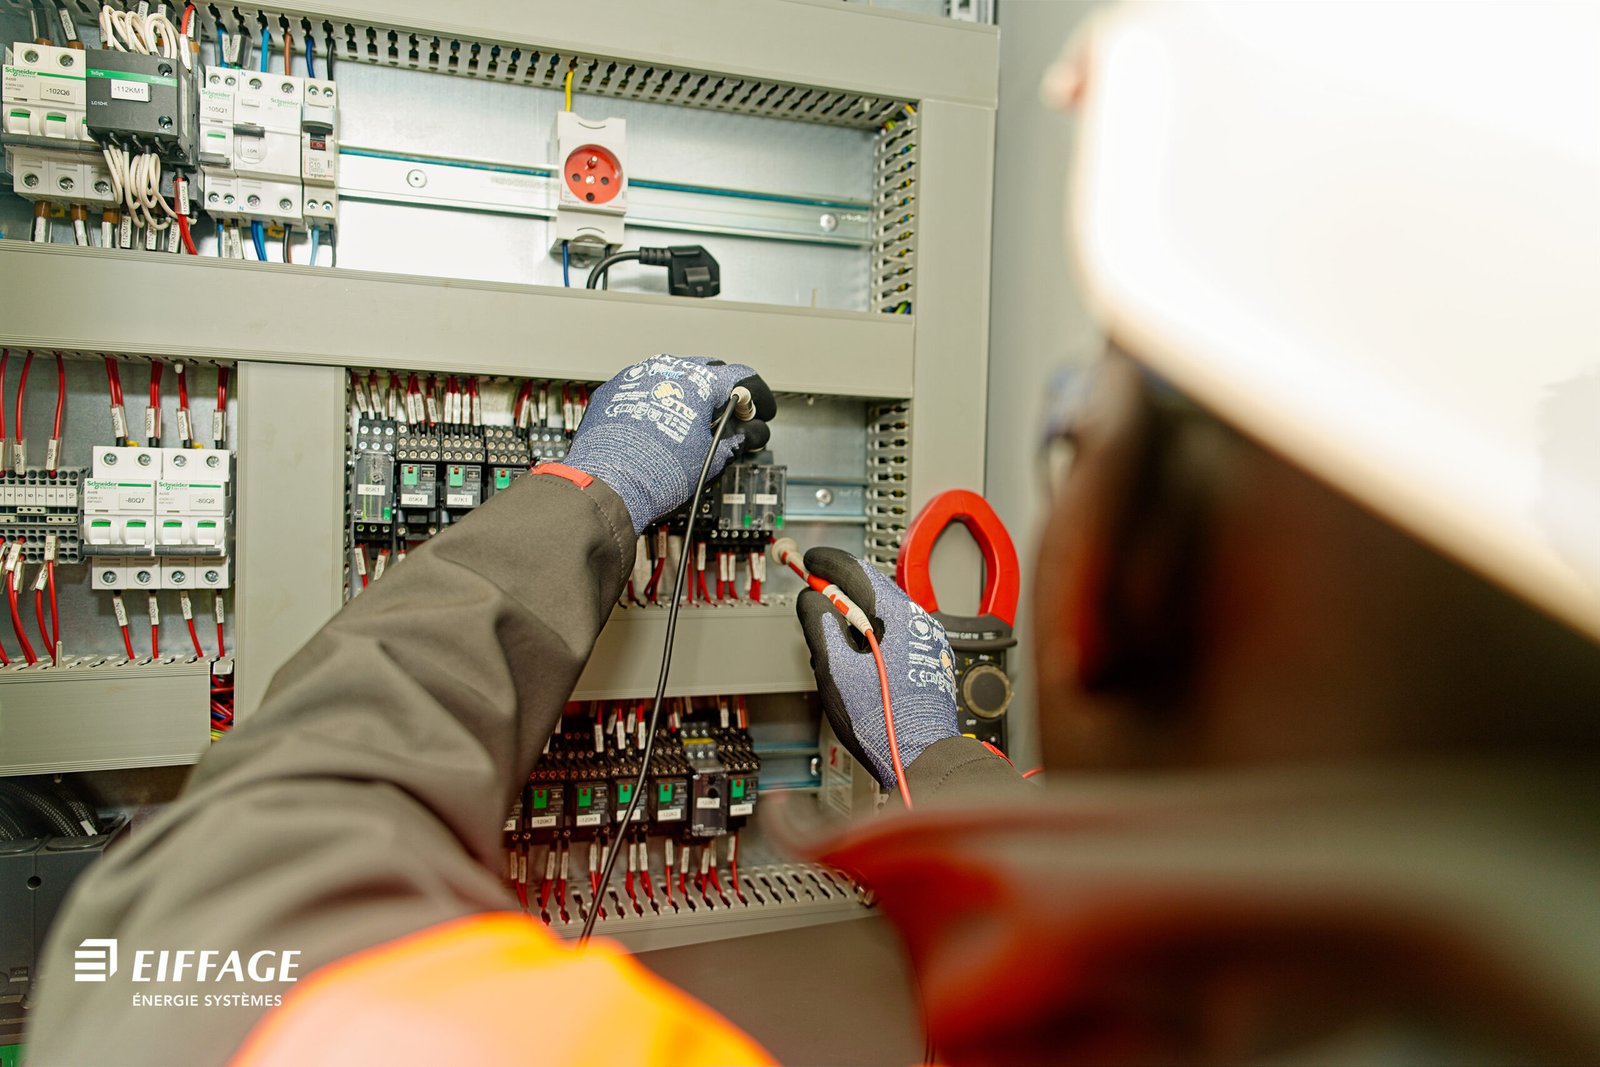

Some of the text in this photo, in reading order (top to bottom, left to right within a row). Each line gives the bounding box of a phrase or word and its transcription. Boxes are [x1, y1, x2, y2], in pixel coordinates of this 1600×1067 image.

[5, 66, 36, 77] Schneider
[46, 88, 70, 96] -102Q6
[114, 86, 144, 94] -112KM1
[201, 89, 231, 99] Schneider
[270, 97, 299, 107] Schneider
[87, 481, 117, 489] Schneider
[158, 482, 188, 490] Schneider
